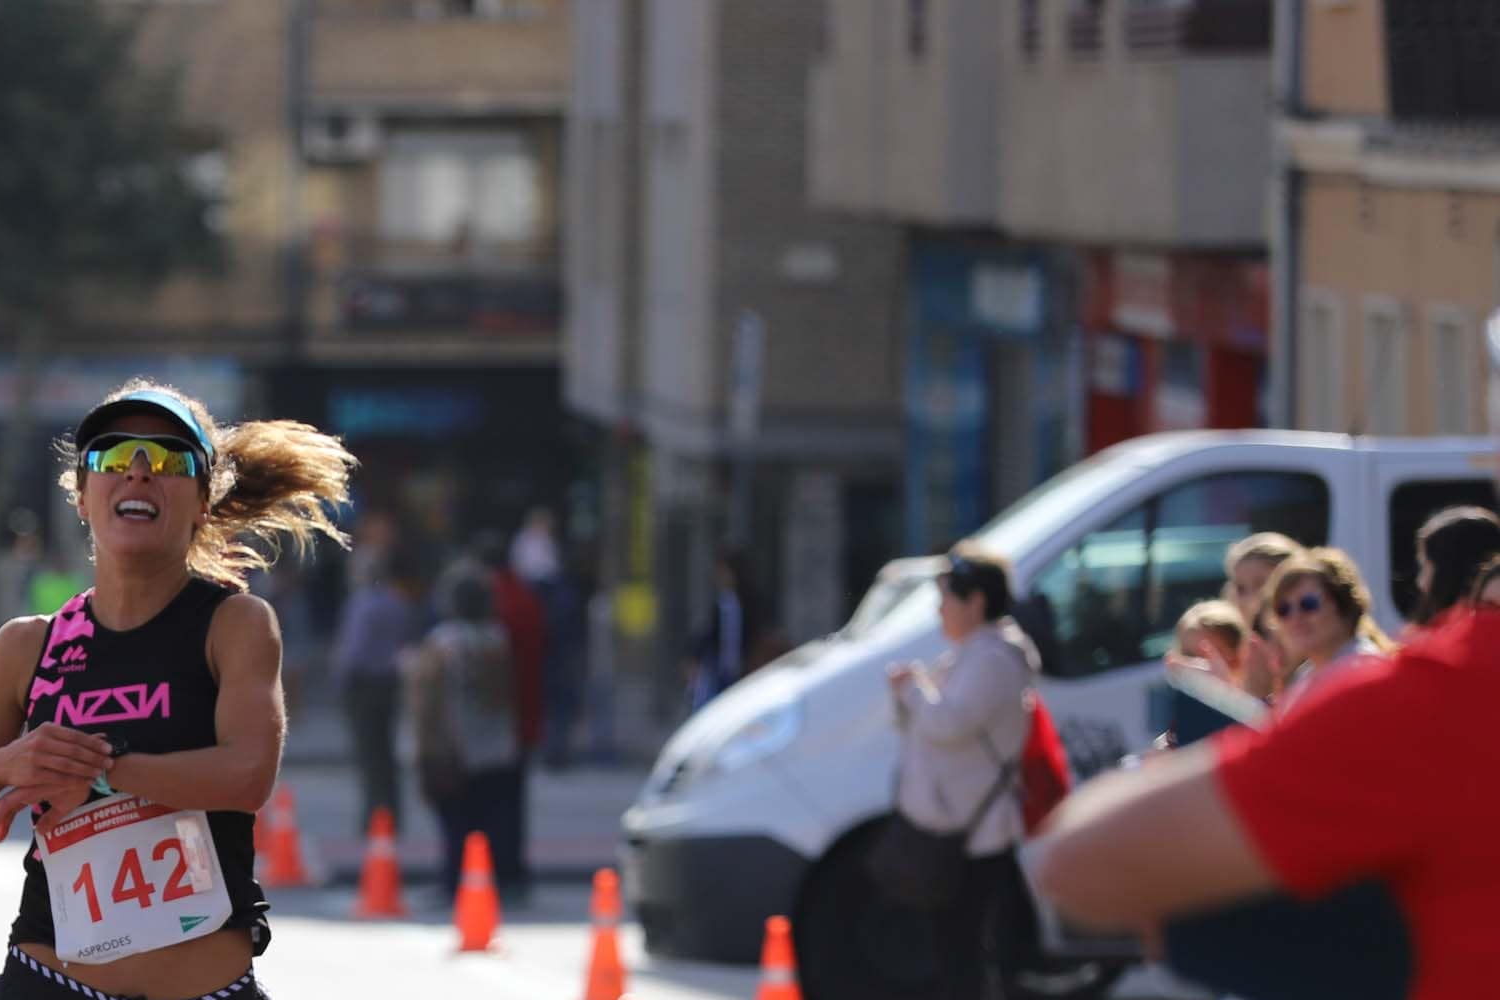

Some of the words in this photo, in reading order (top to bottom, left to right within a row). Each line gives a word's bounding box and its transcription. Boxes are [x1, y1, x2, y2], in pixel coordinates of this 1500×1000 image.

[93, 801, 137, 821] POPULAR
[72, 837, 195, 924] 142
[77, 935, 133, 959] ASPRODES
